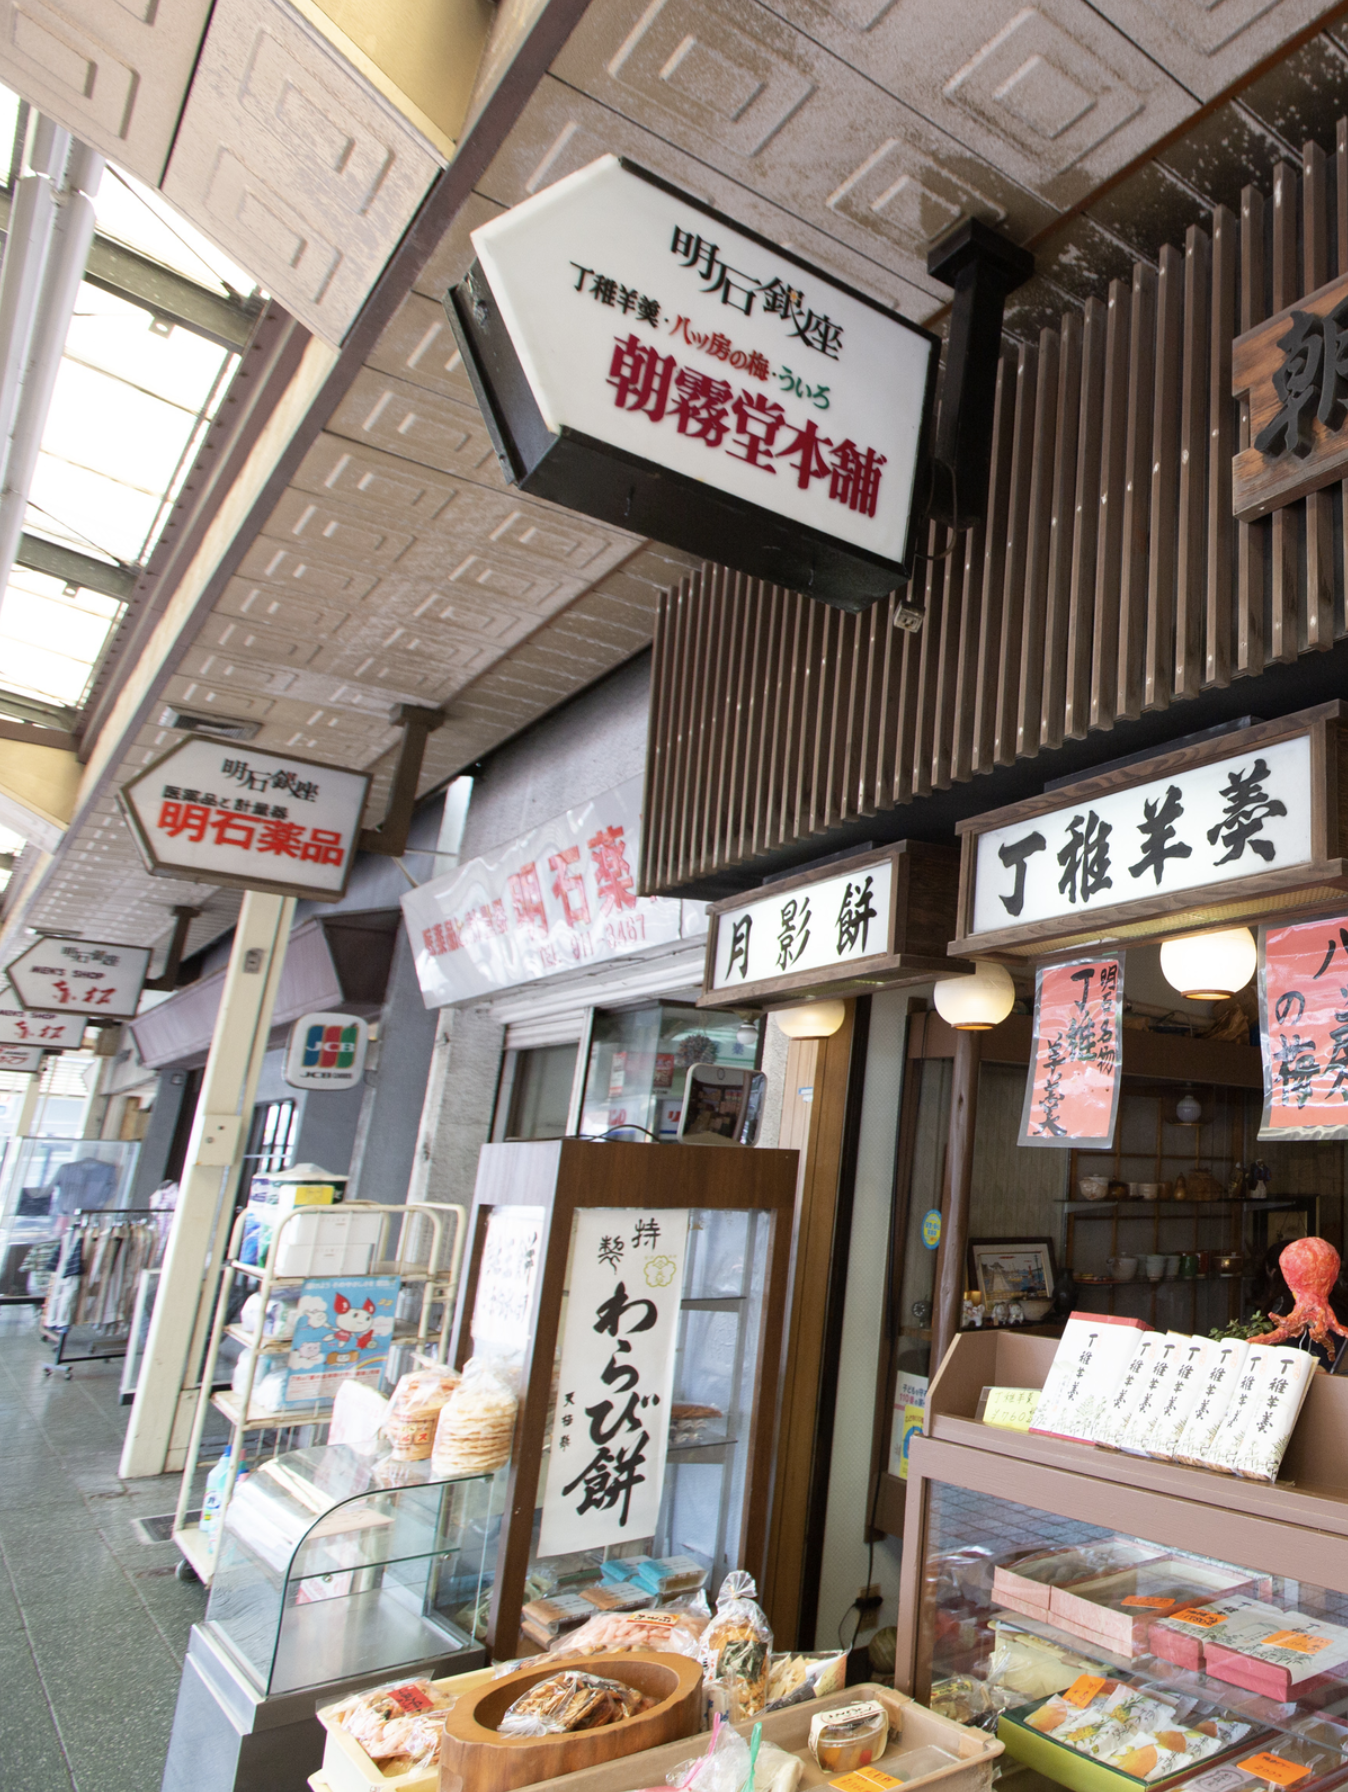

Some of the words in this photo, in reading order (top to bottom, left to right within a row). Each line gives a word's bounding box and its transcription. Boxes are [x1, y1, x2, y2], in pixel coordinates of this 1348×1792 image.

[670, 225, 844, 361] 明石銀座
[606, 333, 888, 518] 朝霧堂本舗
[162, 785, 289, 820] 医薬品と計量器
[221, 758, 319, 803] 明石銀座
[157, 801, 345, 867] 明石薬品
[998, 758, 1288, 917] 丁稚羊羹
[507, 825, 638, 940] 明石薬
[725, 874, 878, 981] 月影餅
[71, 969, 105, 980] SHOP
[306, 1041, 355, 1052] JCB
[1097, 964, 1118, 1075] 明石名物
[299, 1071, 332, 1079] JCB
[1067, 1333, 1098, 1401] 丁稚羊羹
[1113, 1342, 1152, 1409] 丁稚羊羹
[1138, 1344, 1175, 1414] 丁稚羊羹
[1164, 1347, 1201, 1417] 丁稚羊羹
[1195, 1349, 1233, 1421] 丁稚羊羹
[1256, 1359, 1295, 1434] 丁稚羊羹
[562, 1281, 660, 1527] わらび餅
